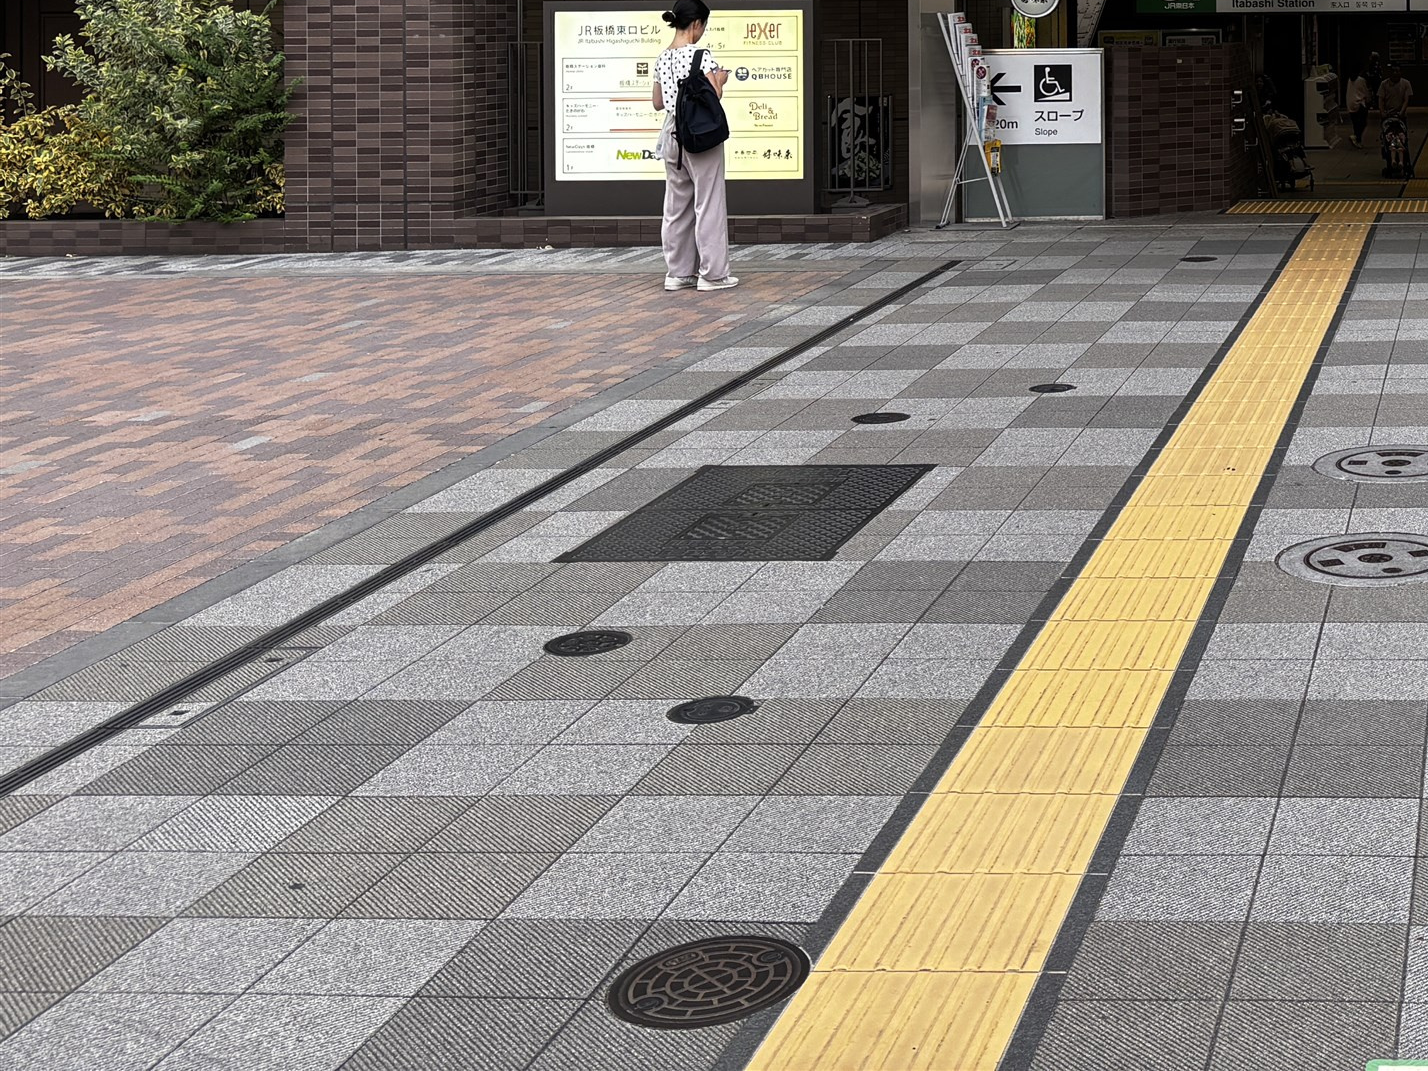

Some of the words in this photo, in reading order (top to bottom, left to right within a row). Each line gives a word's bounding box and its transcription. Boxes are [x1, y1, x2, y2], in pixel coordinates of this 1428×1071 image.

[578, 25, 661, 36] JR板橋東口ビル
[749, 101, 767, 110] Deli
[753, 112, 778, 120] Bread
[1034, 109, 1084, 123] スロープ
[1034, 127, 1058, 137] Slope
